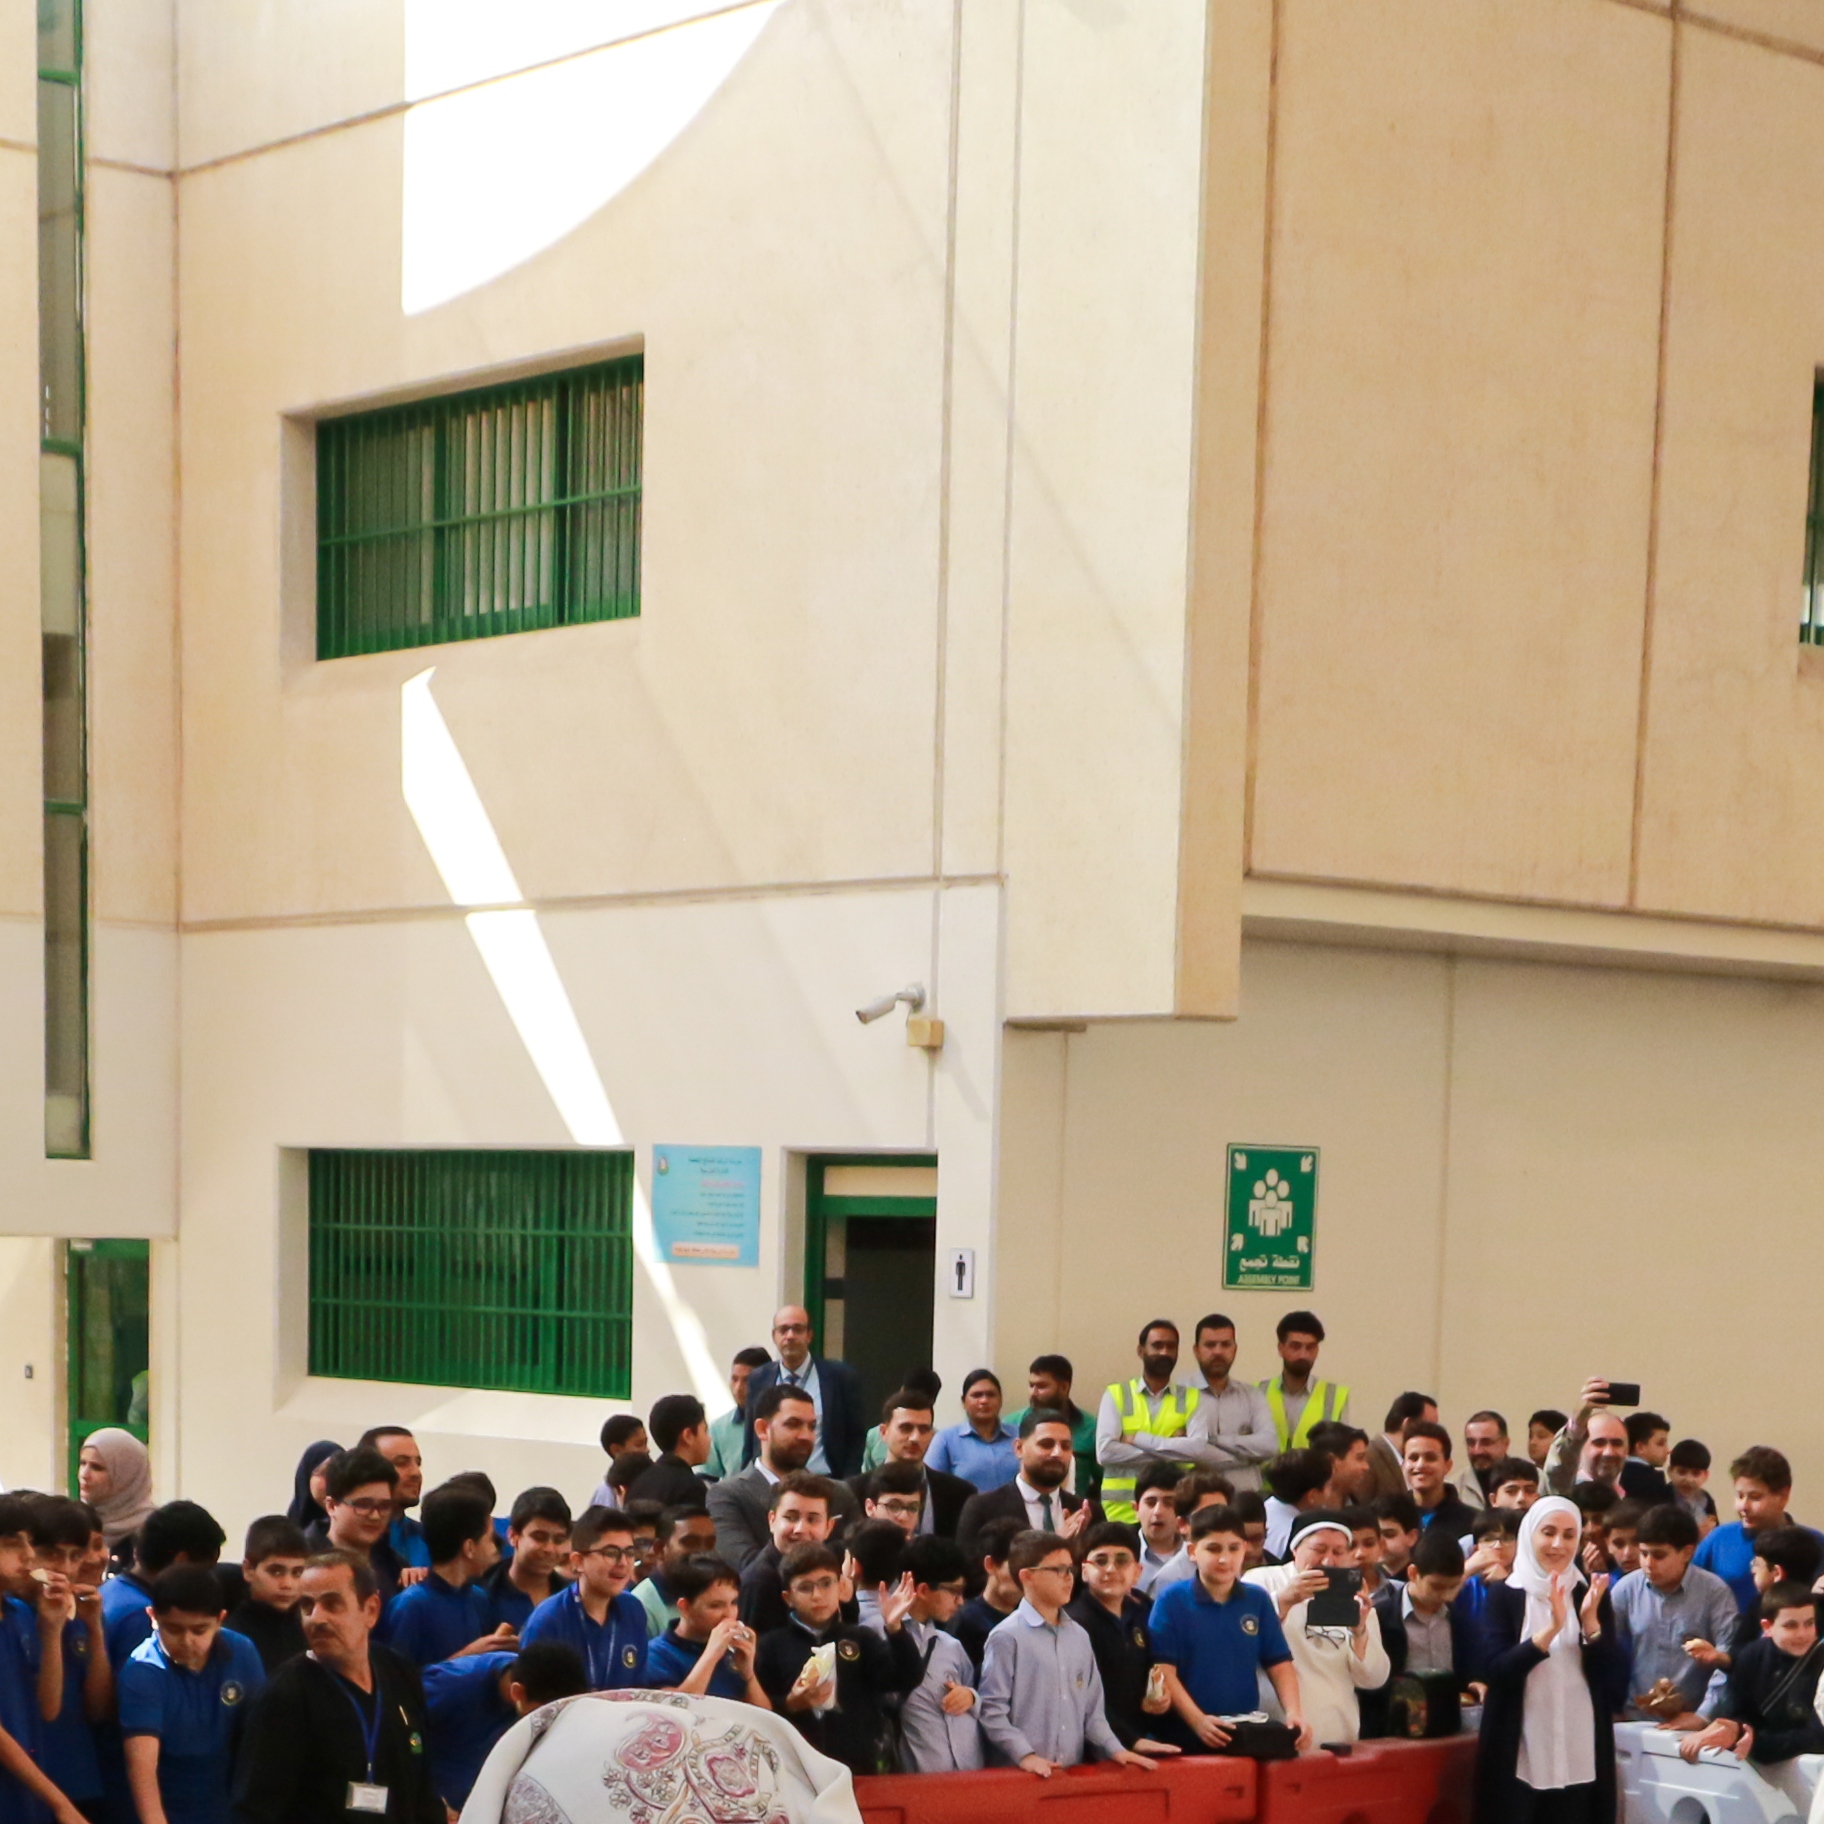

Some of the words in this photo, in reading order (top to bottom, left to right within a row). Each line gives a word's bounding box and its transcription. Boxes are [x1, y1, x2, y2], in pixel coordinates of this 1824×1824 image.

[1239, 1253, 1268, 1272] تجمع
[1272, 1254, 1300, 1268] نقطة
[1237, 1274, 1277, 1285] ASSEMBLY
[1278, 1275, 1300, 1286] POINT
